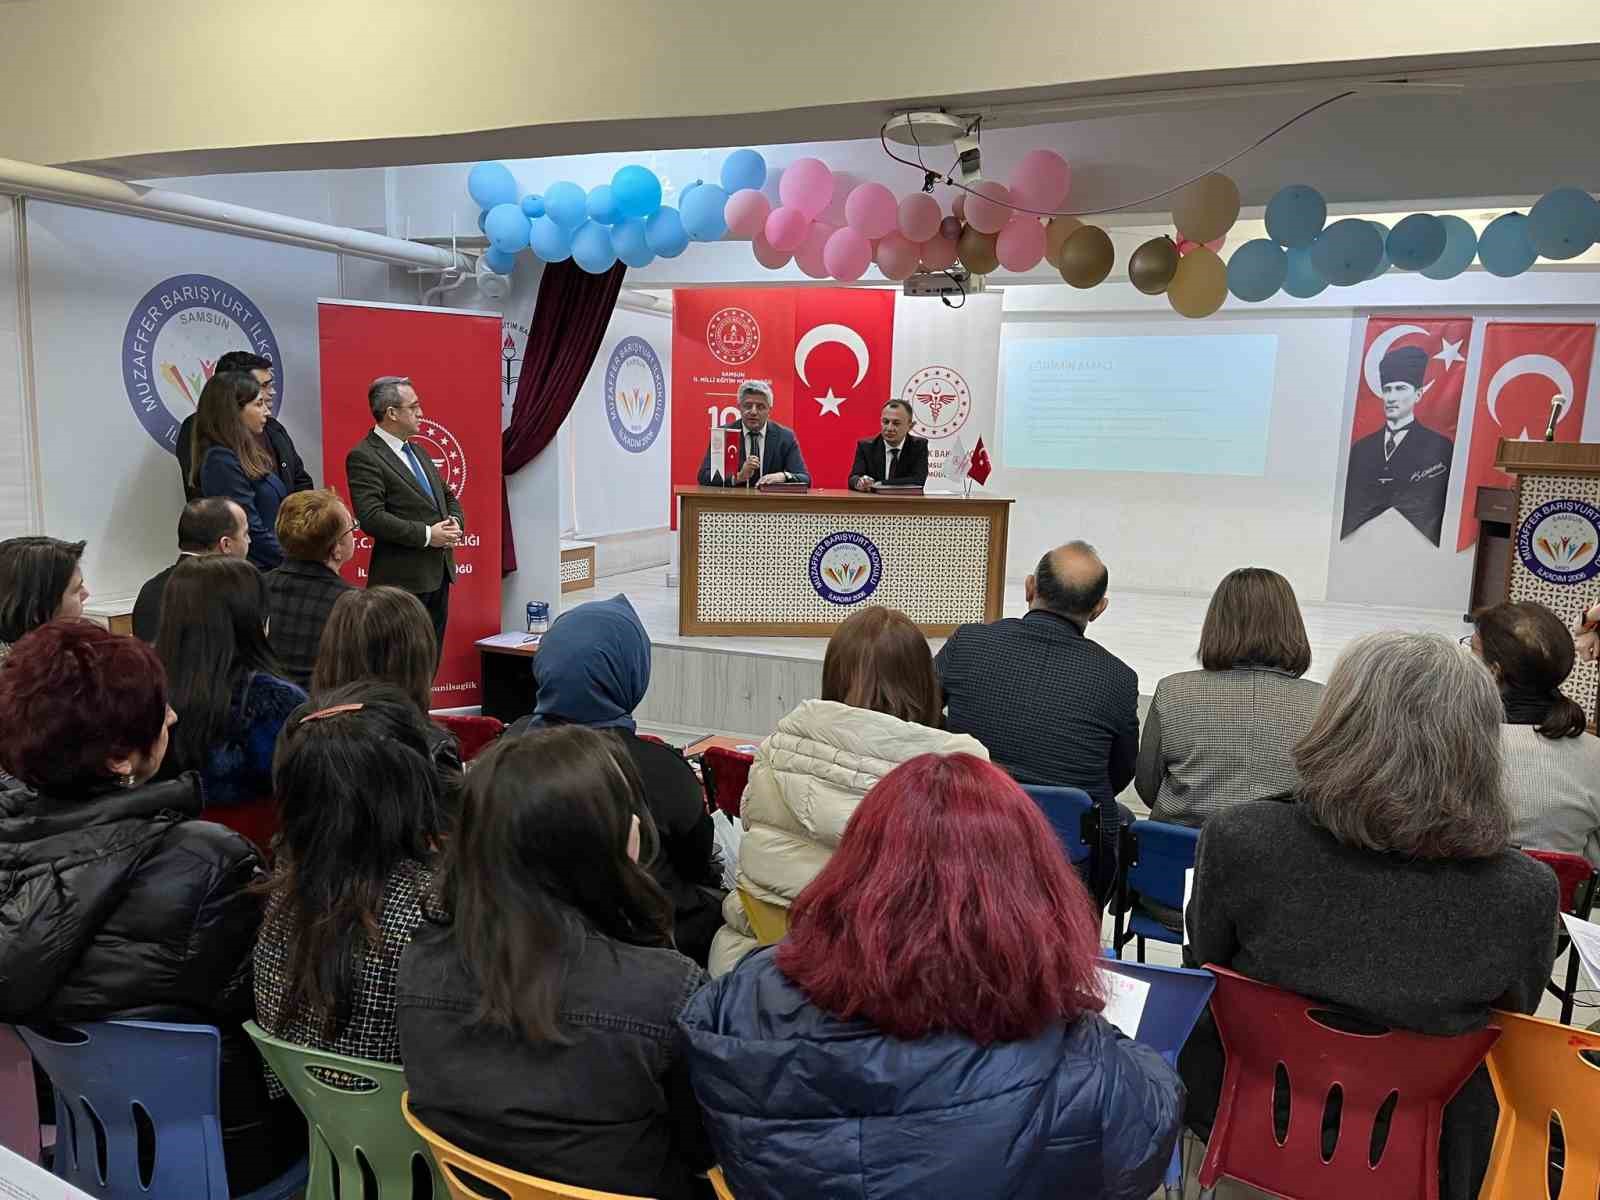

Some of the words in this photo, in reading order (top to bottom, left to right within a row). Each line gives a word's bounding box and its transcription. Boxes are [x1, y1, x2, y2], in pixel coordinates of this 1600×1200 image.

[180, 311, 230, 331] SAMSUN
[134, 306, 163, 412] MUZAFFER
[160, 286, 253, 323] BARIŞYURT
[1520, 510, 1543, 561] MUZAFFER
[811, 545, 826, 589] MUZAFFER
